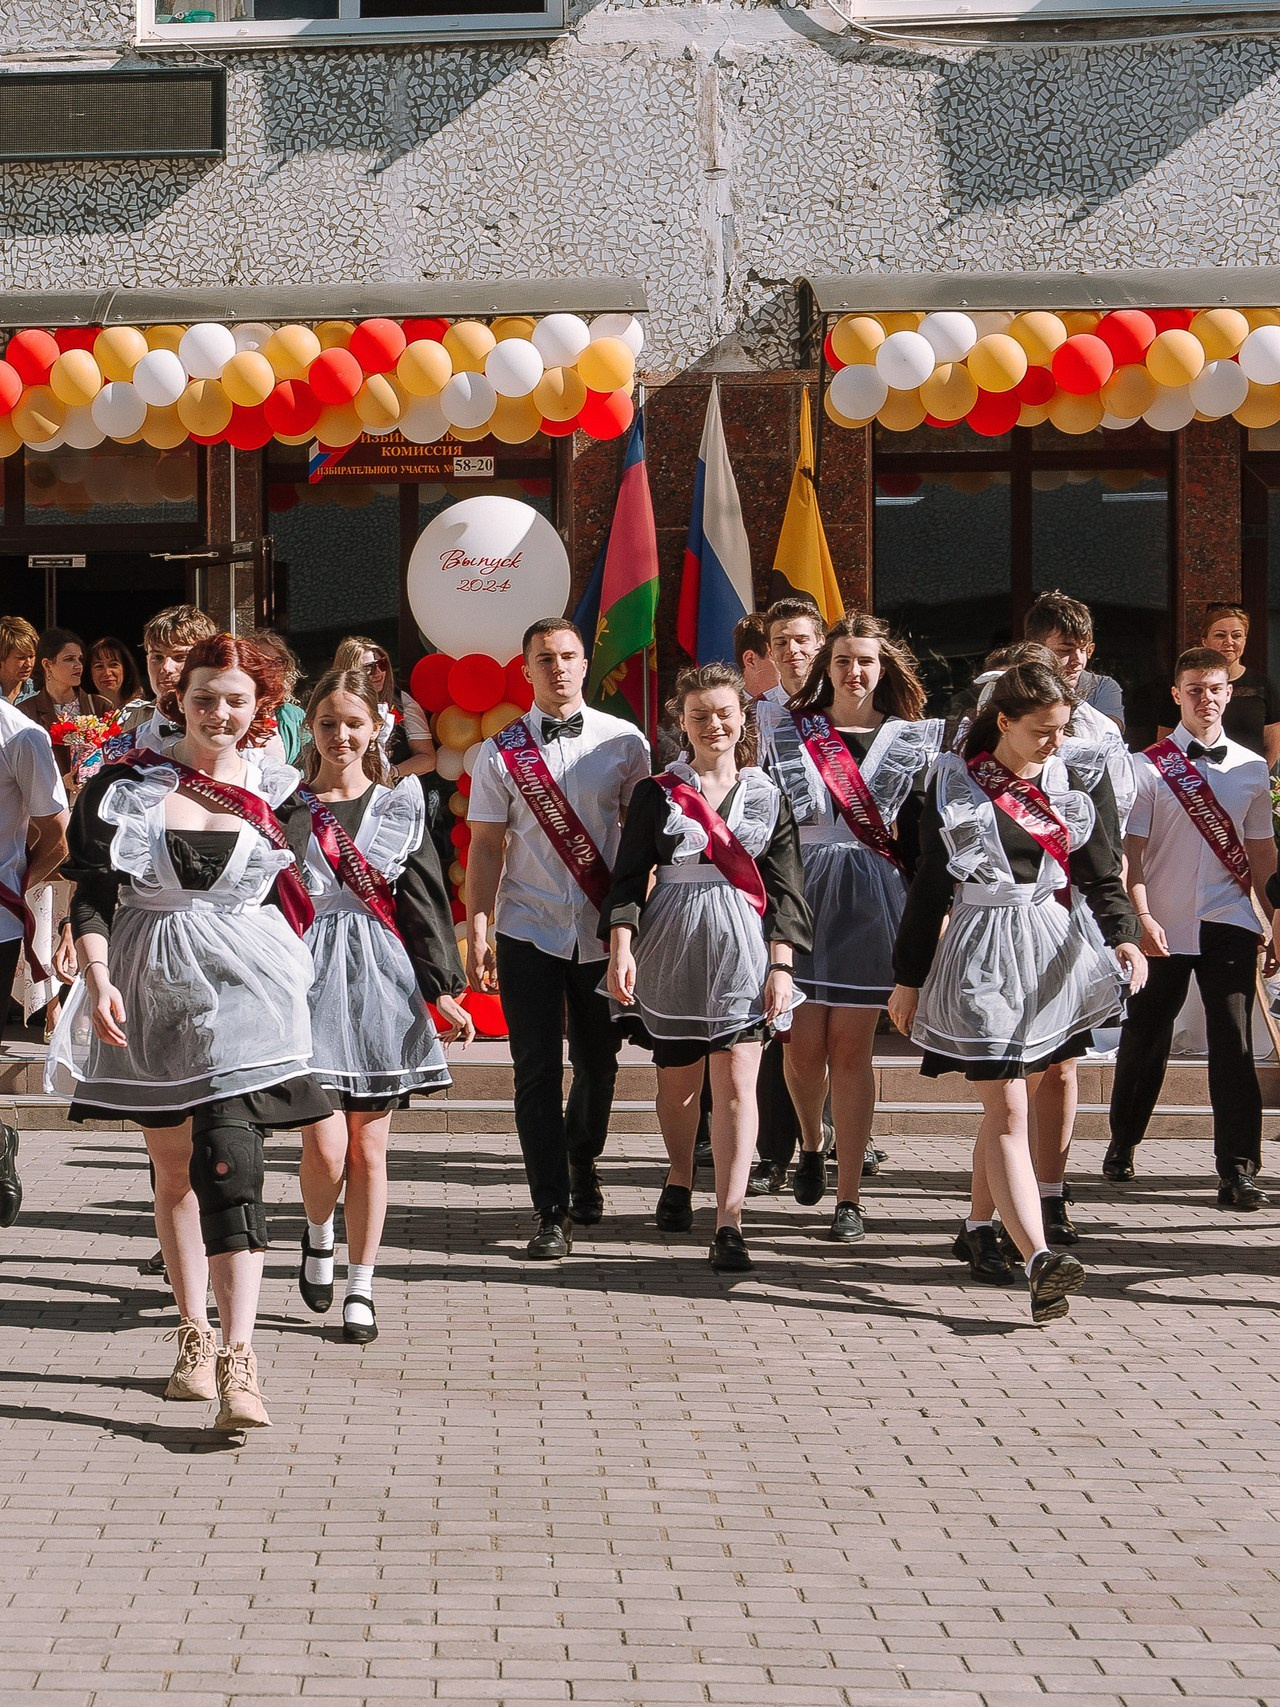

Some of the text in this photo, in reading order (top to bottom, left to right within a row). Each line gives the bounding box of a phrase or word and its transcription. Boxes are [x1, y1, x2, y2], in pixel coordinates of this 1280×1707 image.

[381, 446, 463, 457] КОМИССИЯ
[317, 464, 398, 476] ИЗБИРАТЕЛЬНОГО
[400, 464, 440, 474] УЧАСТКА
[454, 458, 493, 472] 58-20
[439, 550, 523, 575] Выпуск
[456, 579, 511, 592] 2024
[514, 749, 570, 836] Выпускник
[563, 834, 595, 870] 202
[1178, 776, 1232, 848] Выпускник
